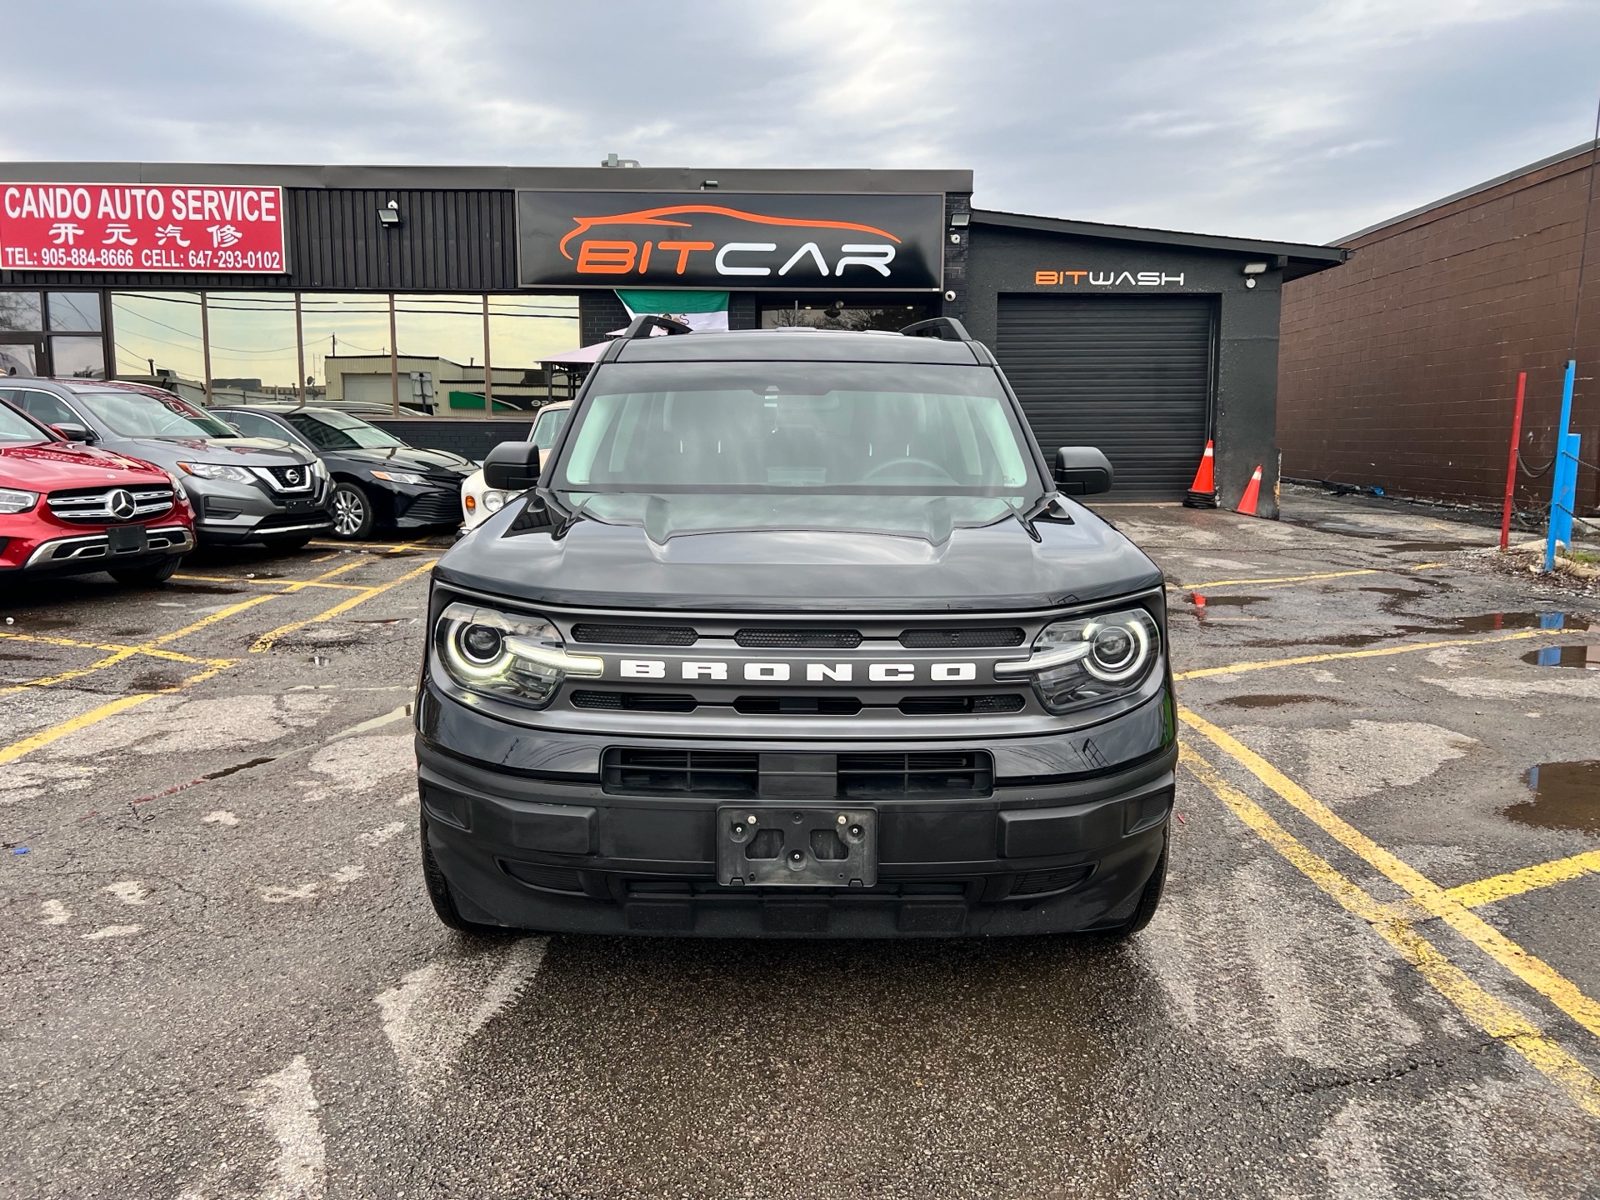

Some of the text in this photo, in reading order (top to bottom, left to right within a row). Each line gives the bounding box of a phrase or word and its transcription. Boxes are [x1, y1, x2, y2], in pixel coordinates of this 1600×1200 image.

[5, 187, 277, 221] CANDO AUTO SERVICE
[48, 223, 243, 248] 开元汽修
[5, 247, 280, 269] TEL: 905-884-8666 CELL: 647-293-0102
[576, 240, 897, 278] BITCAR
[1035, 271, 1185, 286] BITWASH
[620, 660, 976, 681] BRONCO
